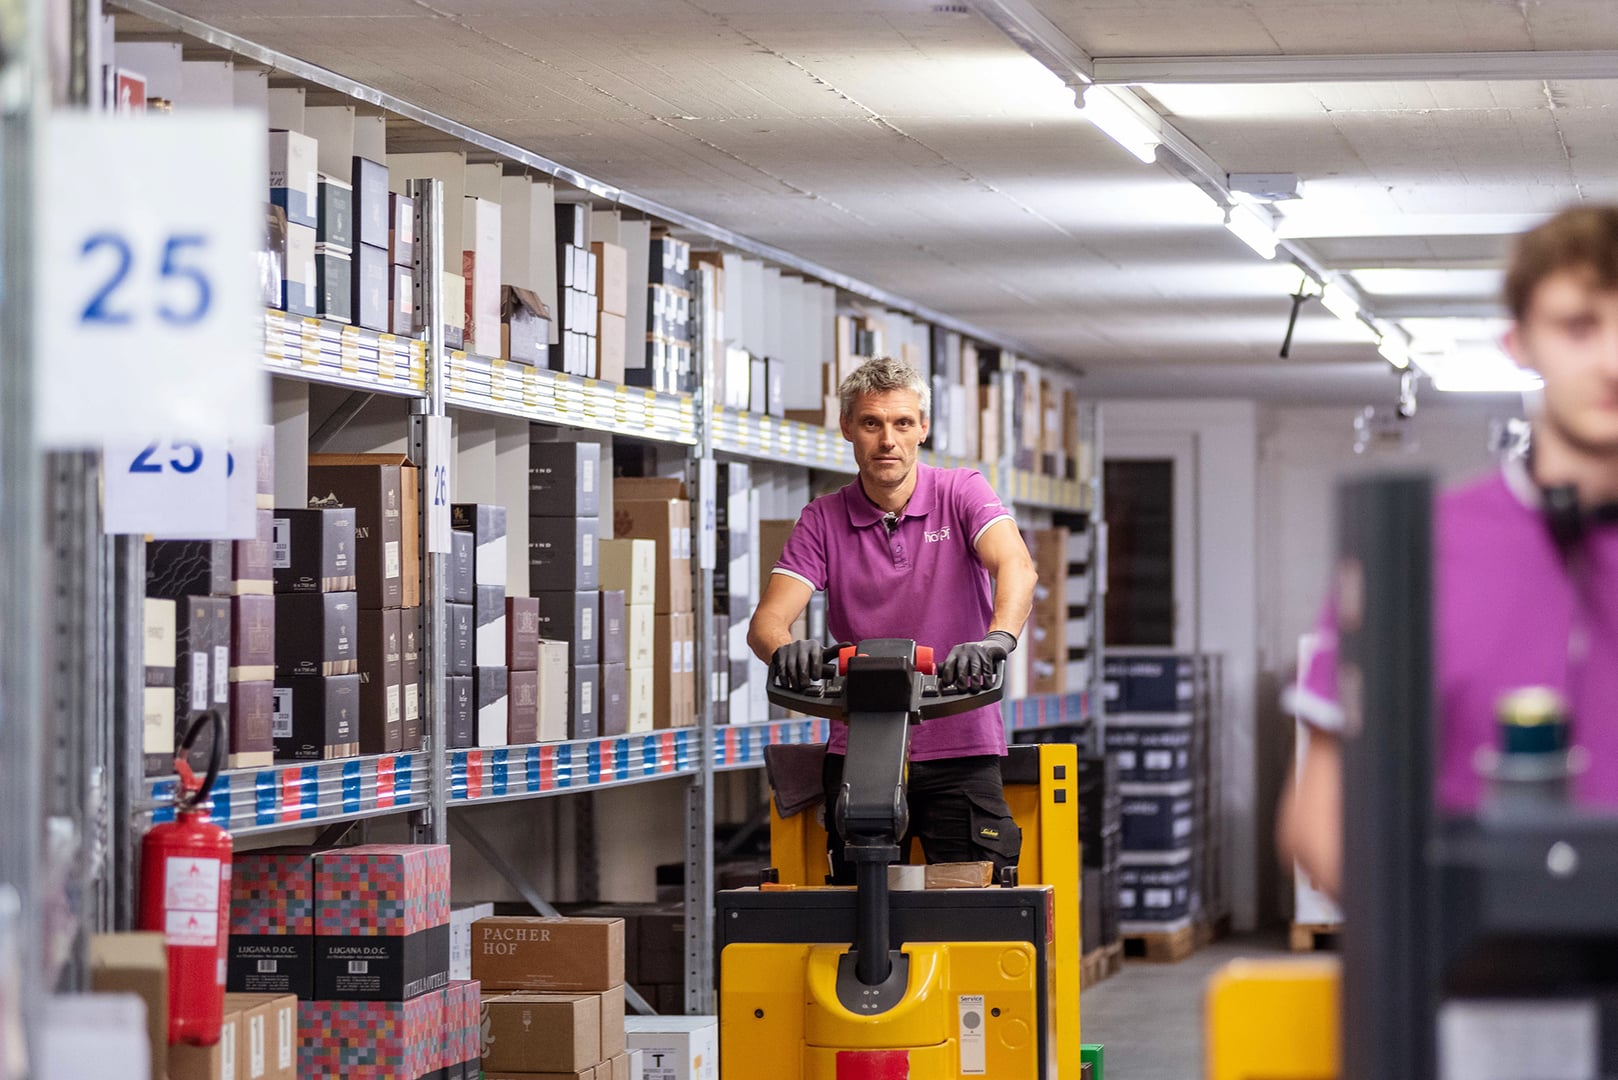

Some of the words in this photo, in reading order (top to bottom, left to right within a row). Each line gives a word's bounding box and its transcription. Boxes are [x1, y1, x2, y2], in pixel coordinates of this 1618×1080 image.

[79, 231, 212, 326] 25
[129, 437, 203, 474] 25
[434, 464, 446, 506] 26
[483, 928, 550, 941] PACHER
[238, 946, 271, 954] LUGANA
[272, 946, 296, 954] D.O.C.
[329, 947, 362, 955] LUGANA
[363, 947, 387, 955] D.O.C.
[483, 942, 517, 955] HOF
[652, 1054, 664, 1067] T
